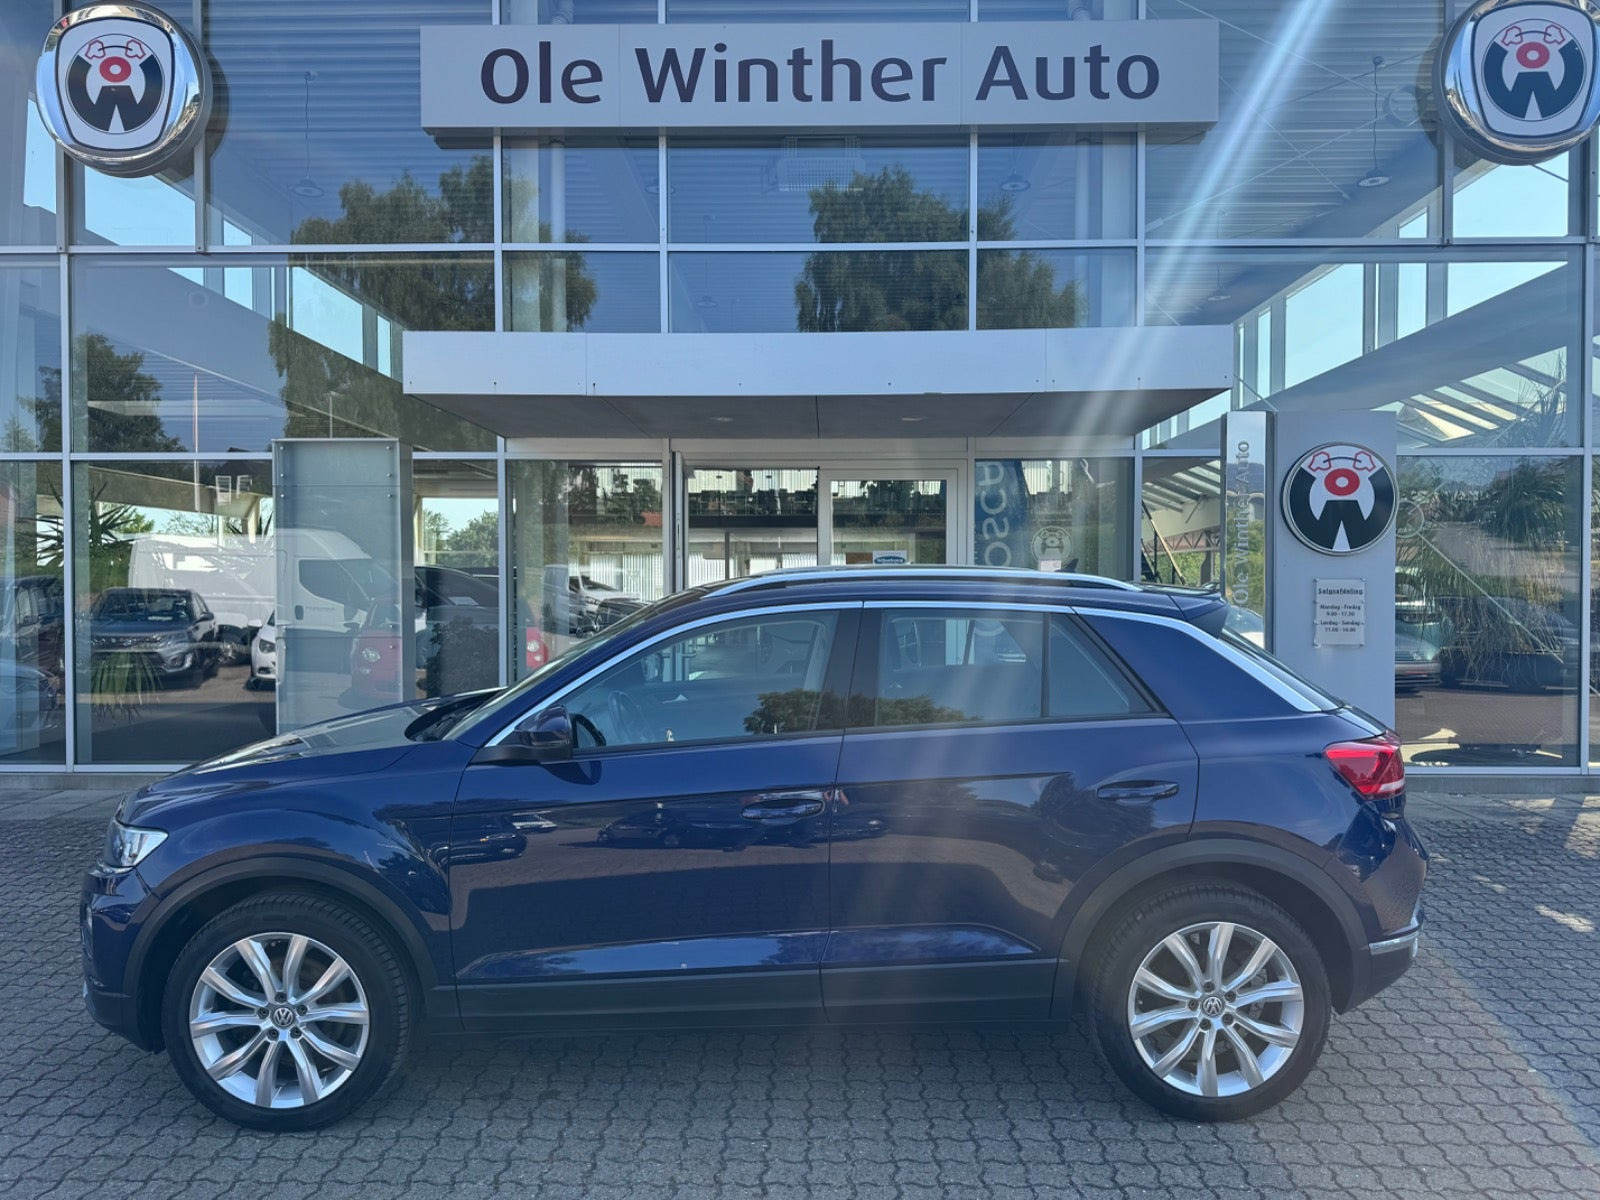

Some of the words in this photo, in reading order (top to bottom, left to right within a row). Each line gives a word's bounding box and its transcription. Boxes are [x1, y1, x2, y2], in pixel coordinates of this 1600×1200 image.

[480, 41, 602, 104] Ole
[634, 40, 948, 103] Winther
[975, 44, 1160, 101] Auto
[1235, 440, 1250, 484] Auto
[1234, 490, 1249, 566] Winther
[1233, 572, 1249, 605] Ole
